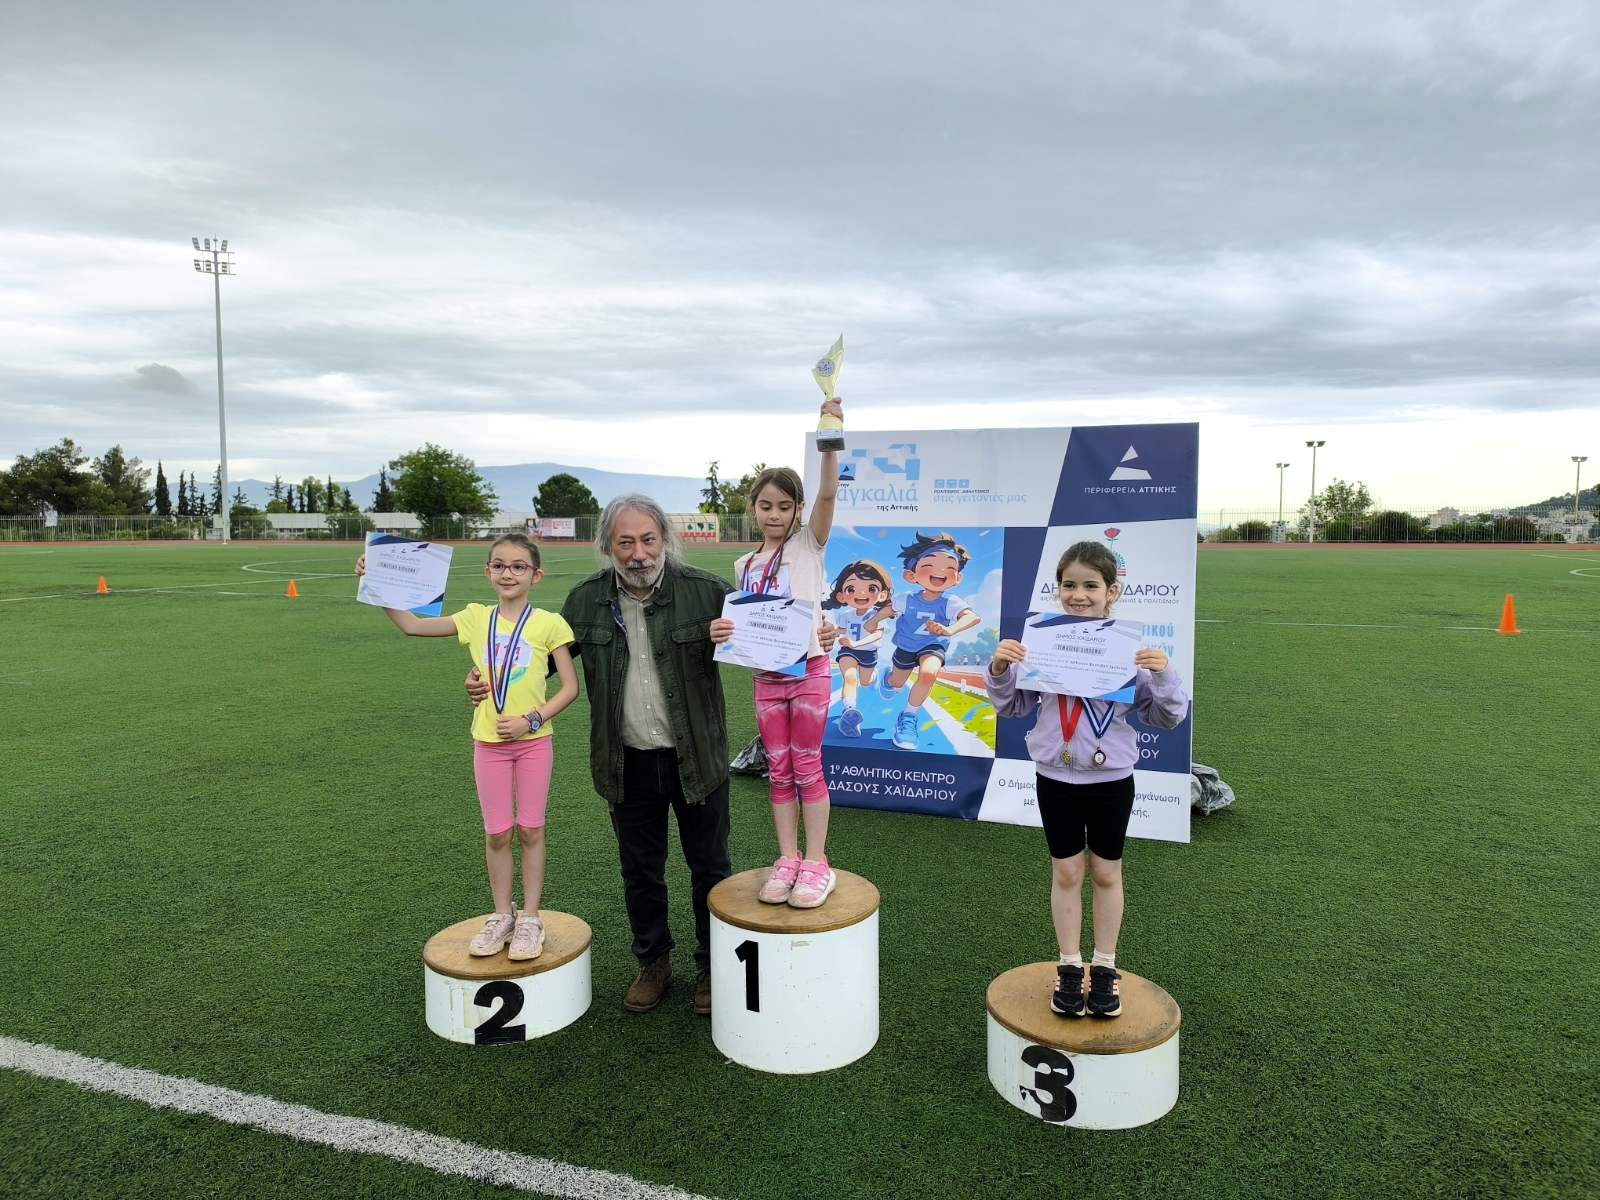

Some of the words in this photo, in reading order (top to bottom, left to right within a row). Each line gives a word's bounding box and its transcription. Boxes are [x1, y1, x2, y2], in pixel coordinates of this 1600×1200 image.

[836, 483, 919, 506] αγκαλιά
[876, 504, 889, 512] της
[890, 503, 919, 512] Αττικής
[1123, 584, 1179, 596] ΔΑΡΙΟΥ
[841, 766, 901, 780] ΑΘΛΗΤΙΚΟ
[904, 771, 956, 785] ΚΕΝΤΡΟ
[828, 780, 880, 795] ΔΑΣΟΥΣ
[884, 785, 957, 801] ΧΑΪΔΑΡΙΟΥ
[998, 779, 1006, 787] Ο
[1008, 779, 1036, 791] Δήμος
[1135, 791, 1180, 806] ργάνωση
[1023, 798, 1035, 806] με
[735, 940, 760, 1012] 1
[474, 981, 526, 1046] 2
[1019, 1045, 1077, 1122] 3
